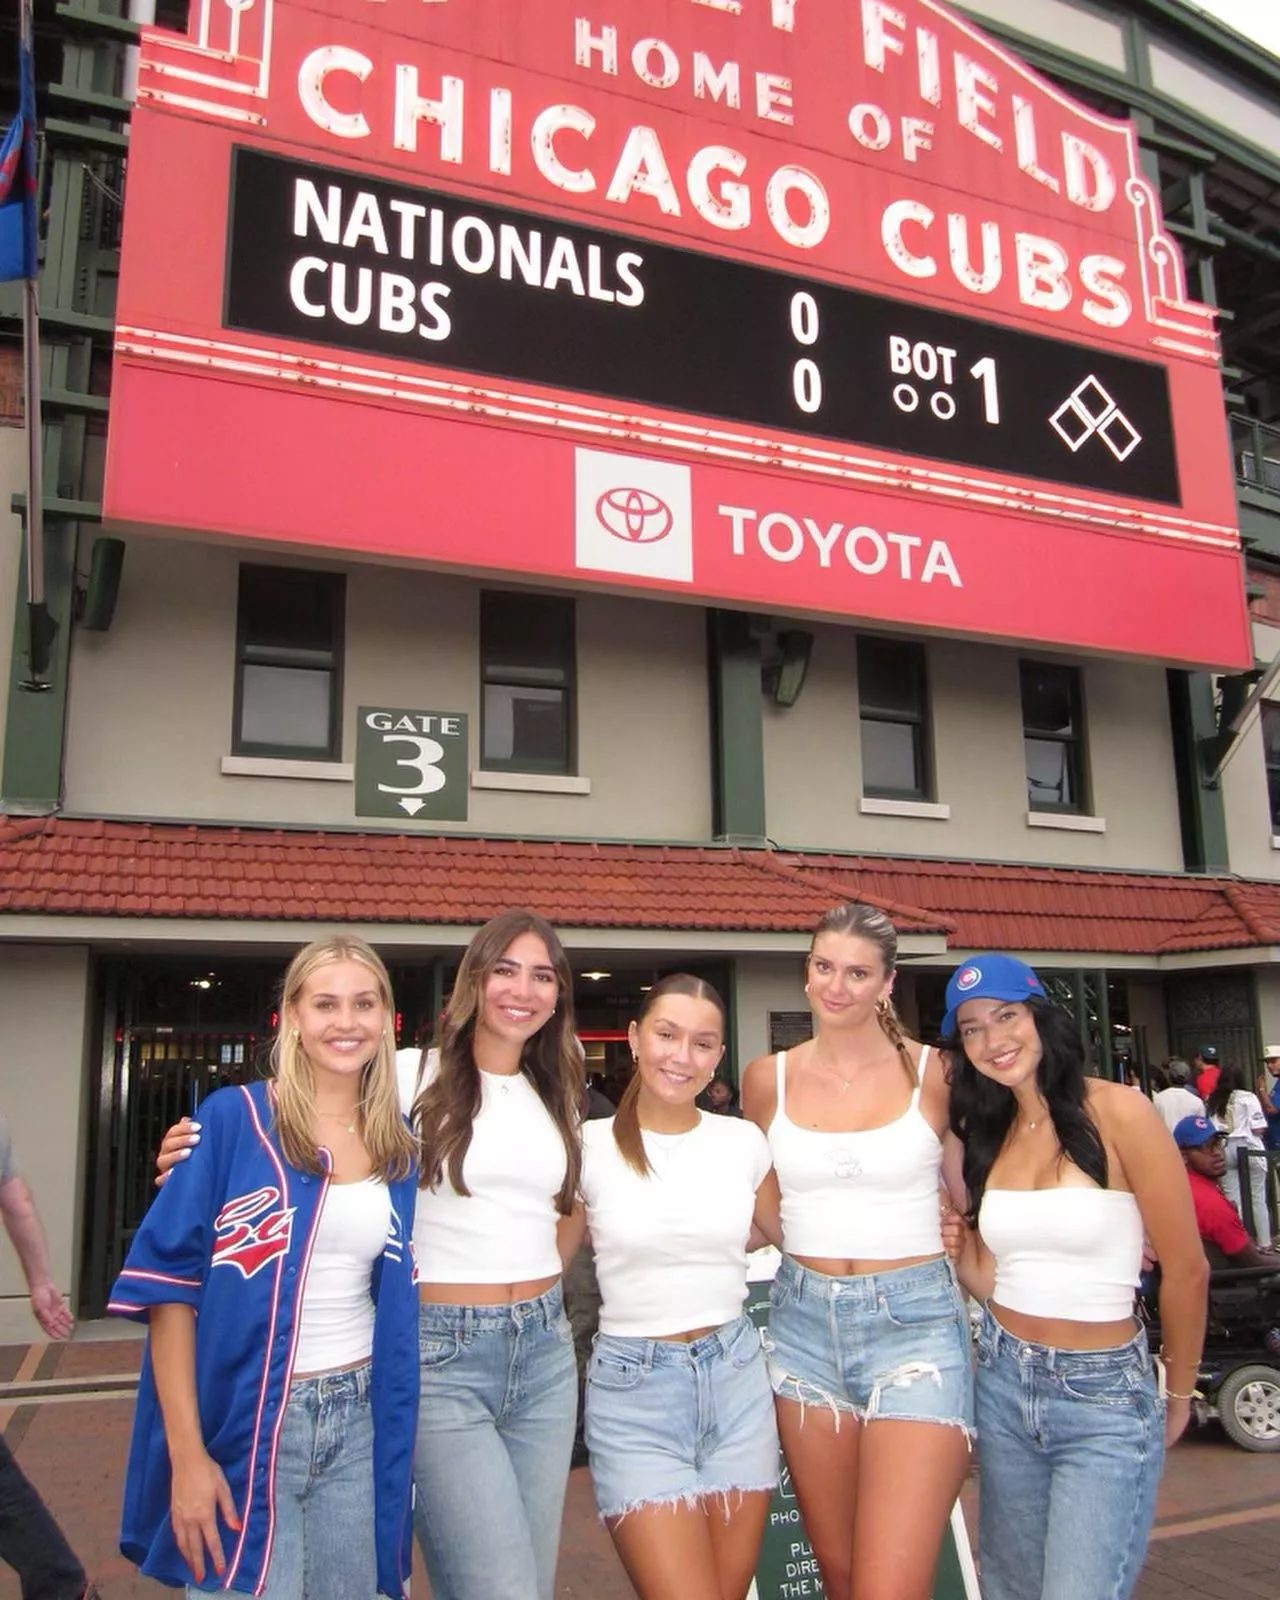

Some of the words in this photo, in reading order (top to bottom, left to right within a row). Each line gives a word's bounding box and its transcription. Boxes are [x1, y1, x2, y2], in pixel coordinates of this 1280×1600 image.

[575, 16, 794, 126] HOME
[848, 103, 936, 163] OF
[861, 0, 1117, 212] FIELD
[298, 45, 831, 249] CHICAGO
[881, 199, 1133, 328] CUBS
[293, 178, 645, 307] NATIONALS
[790, 291, 819, 345] 0
[289, 256, 452, 341] CUBS
[793, 358, 822, 413] 0
[889, 335, 957, 385] BOT
[969, 356, 1000, 425] 1
[717, 504, 963, 587] TOYOTA
[365, 711, 460, 736] GATE
[377, 734, 446, 795] 3
[780, 1580, 811, 1598] THE
